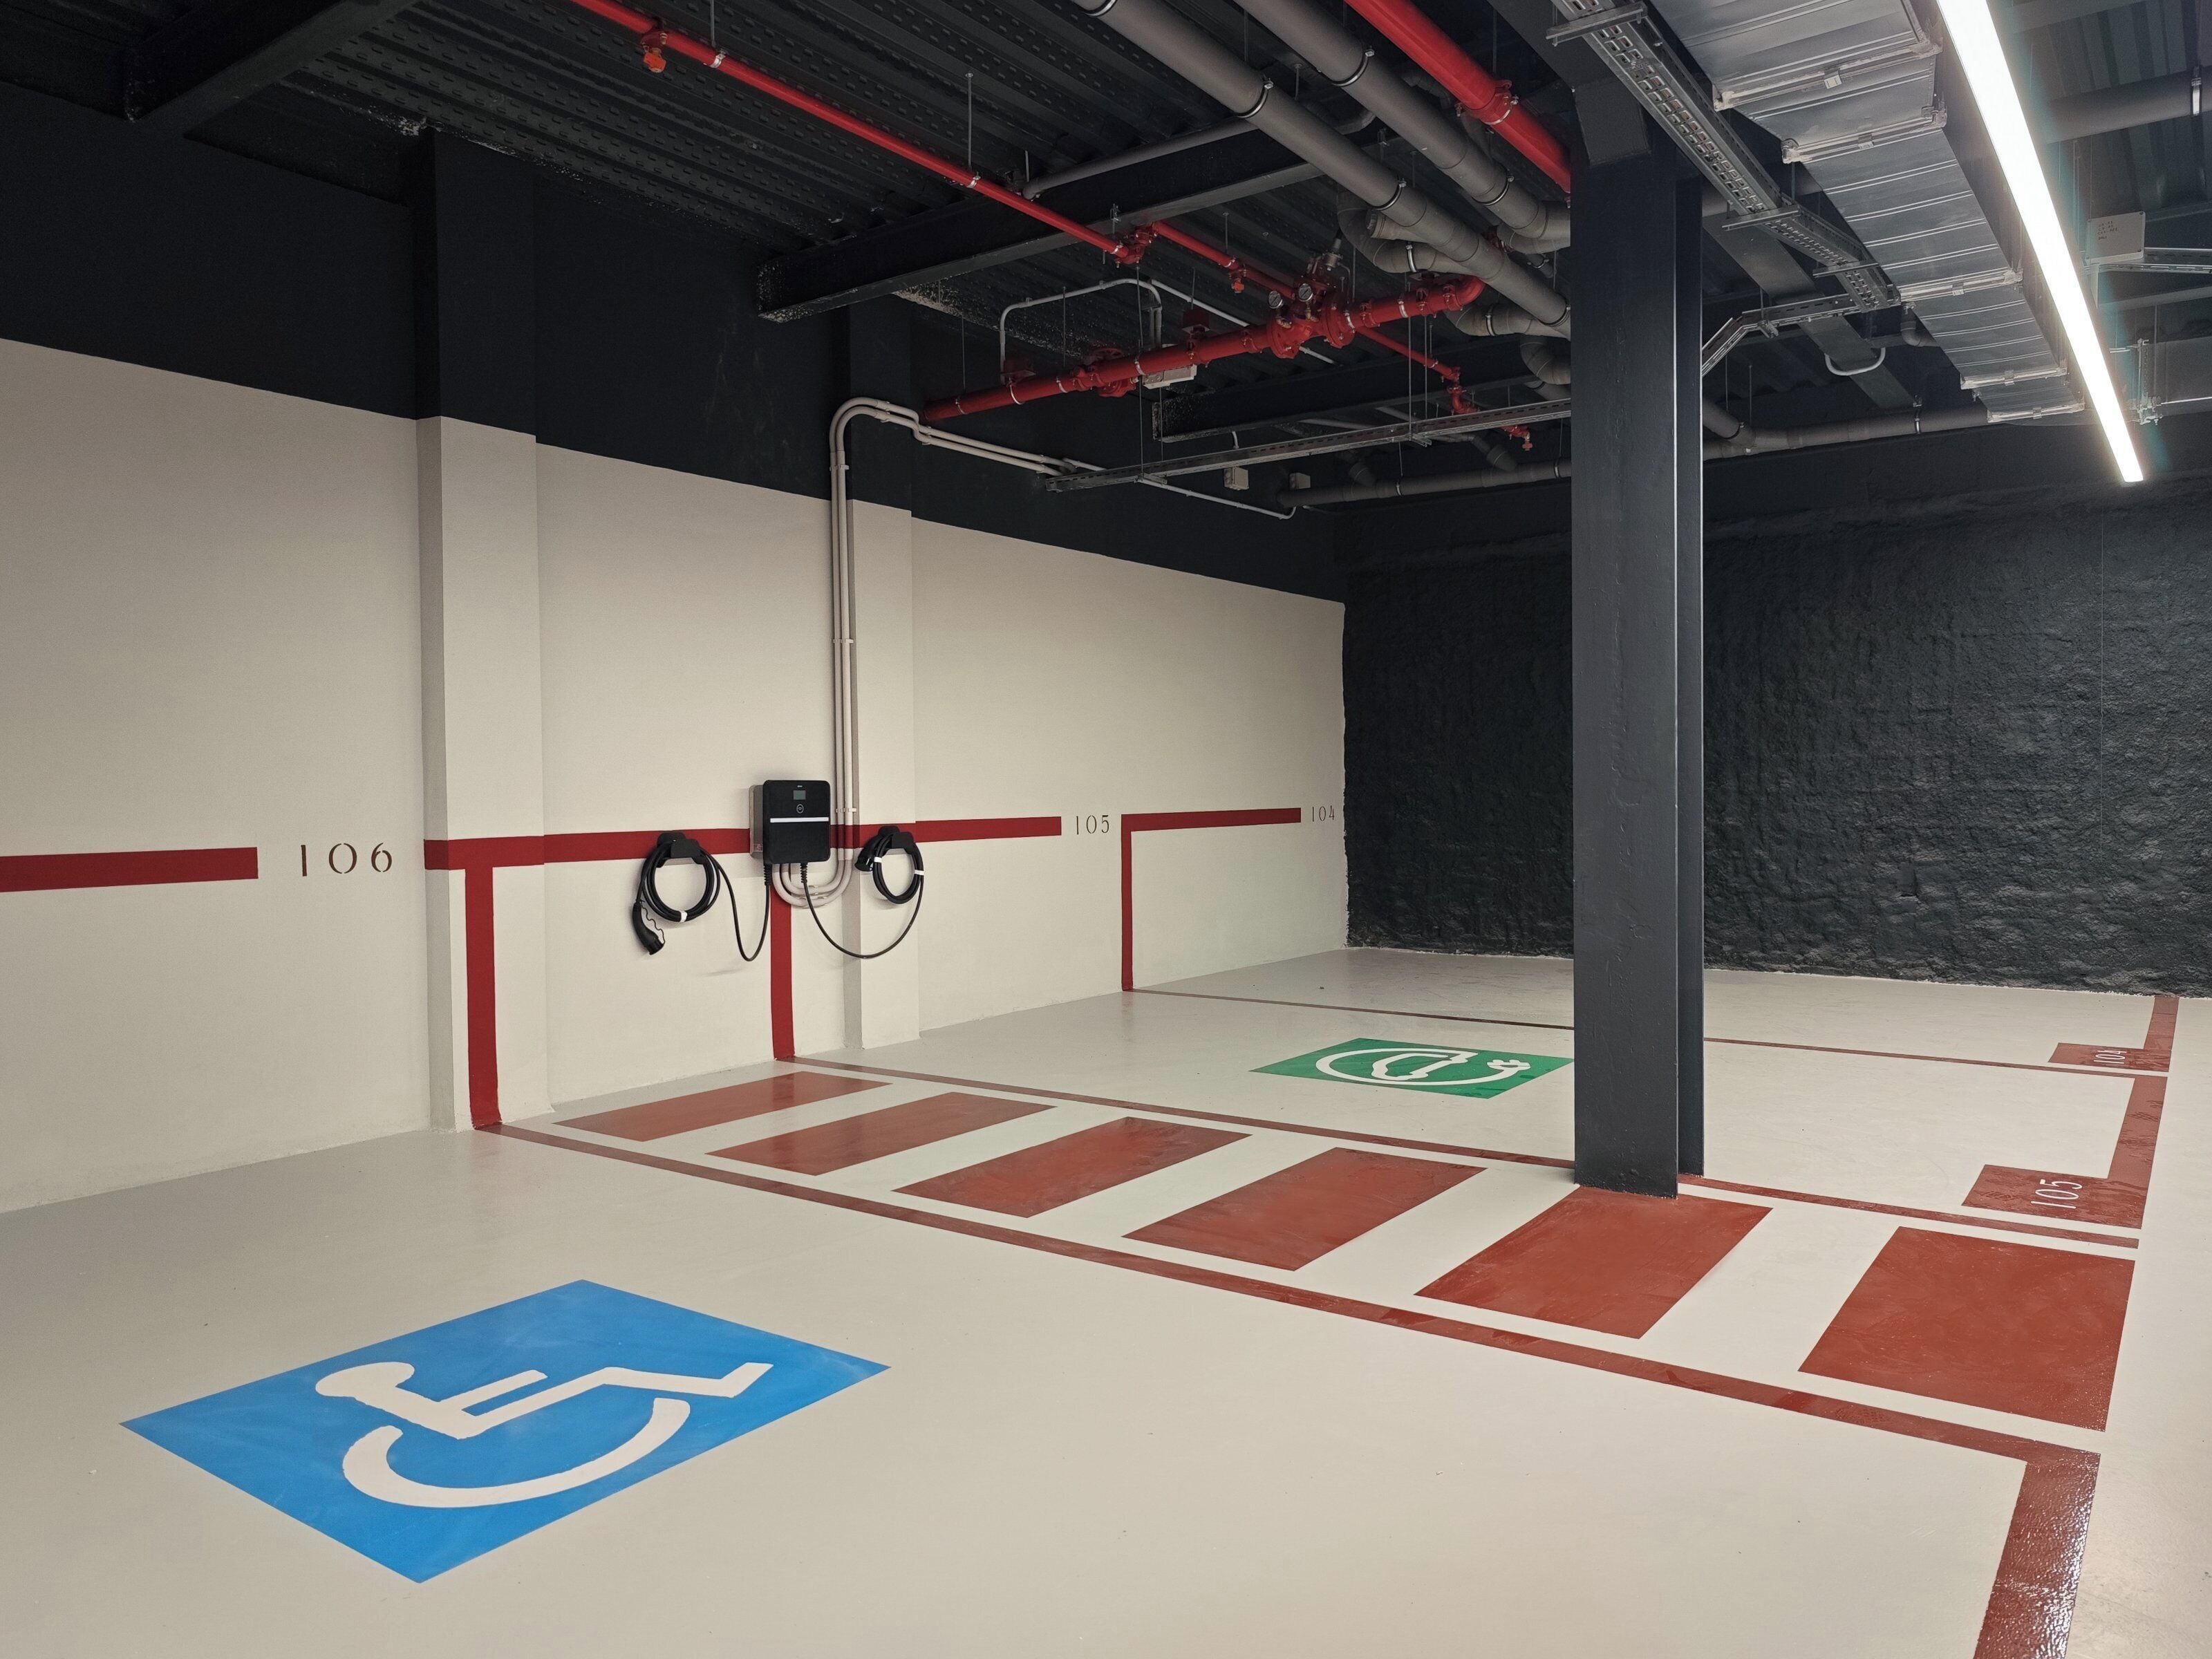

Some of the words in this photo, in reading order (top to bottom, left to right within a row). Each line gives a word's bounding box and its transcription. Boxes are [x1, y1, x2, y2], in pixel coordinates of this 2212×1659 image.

[1312, 805, 1335, 822] 104
[1076, 815, 1109, 835] 105
[301, 843, 393, 877] 106
[2094, 1050, 2127, 1064] 104
[2031, 1179, 2083, 1209] 105
